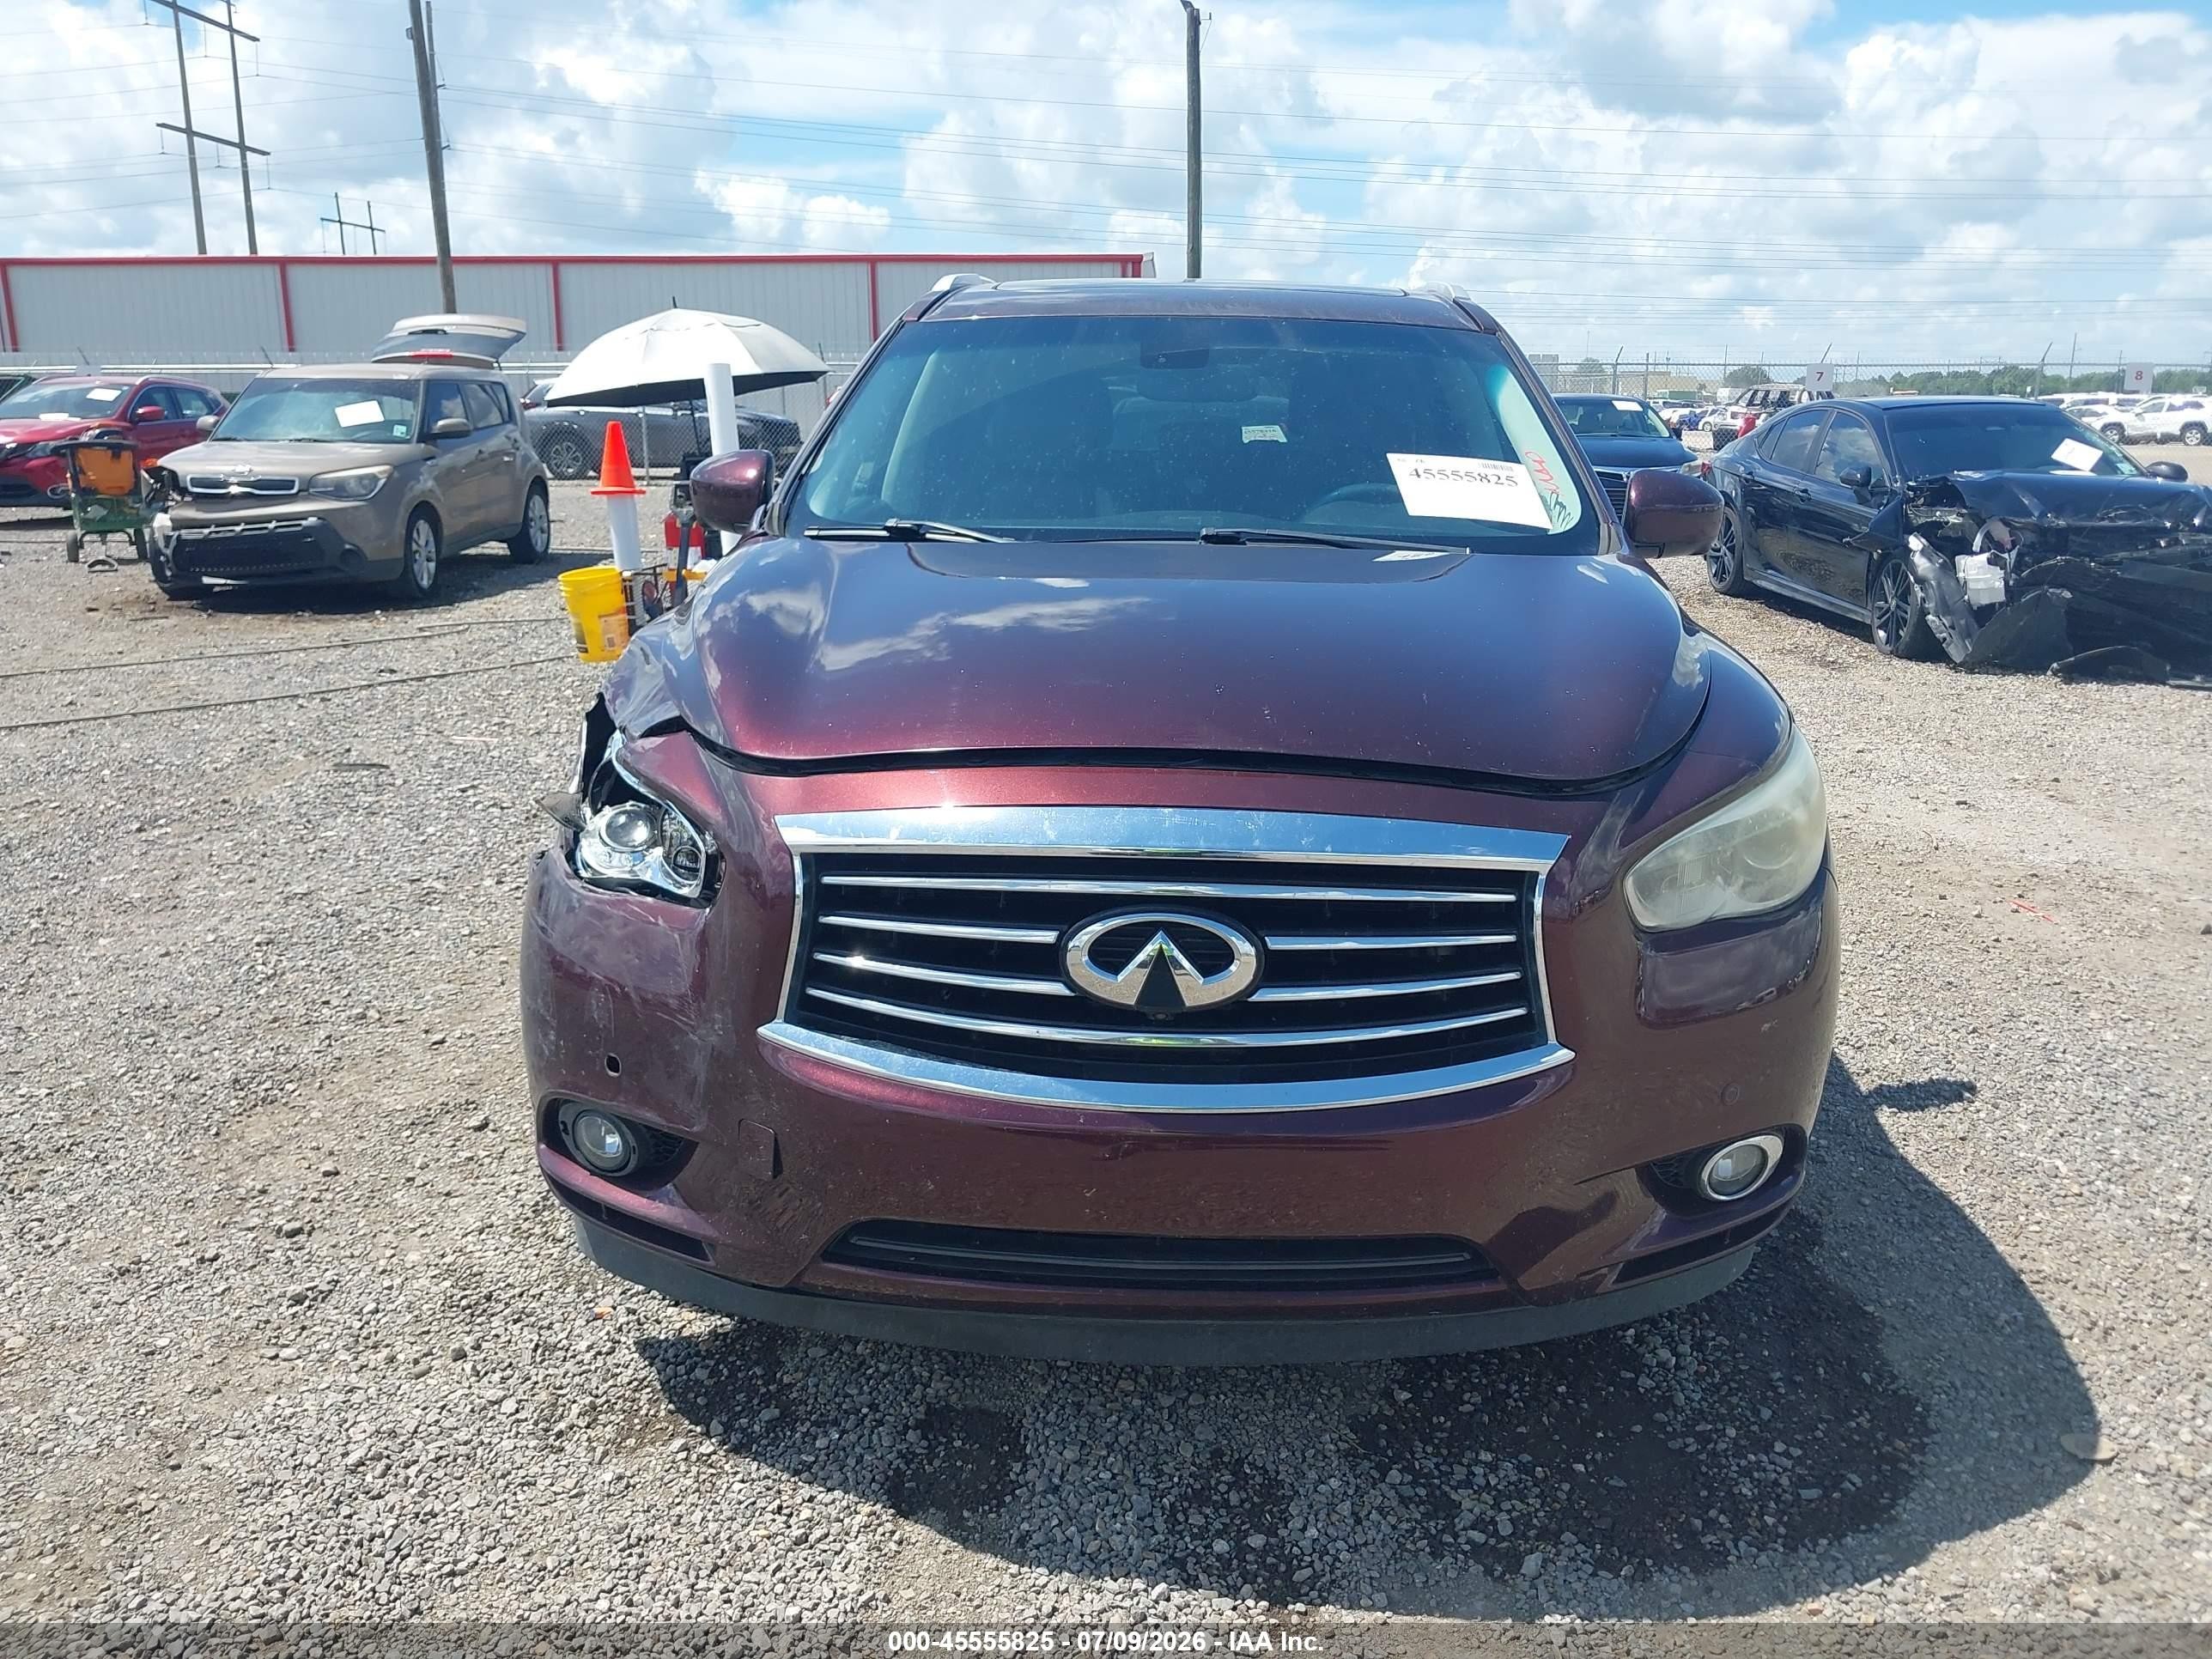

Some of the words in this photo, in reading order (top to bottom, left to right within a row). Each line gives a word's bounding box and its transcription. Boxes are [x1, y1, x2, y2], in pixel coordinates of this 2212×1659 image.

[1816, 371, 1825, 381] 7
[2135, 370, 2143, 380] 8
[1409, 467, 1518, 488] 45555825
